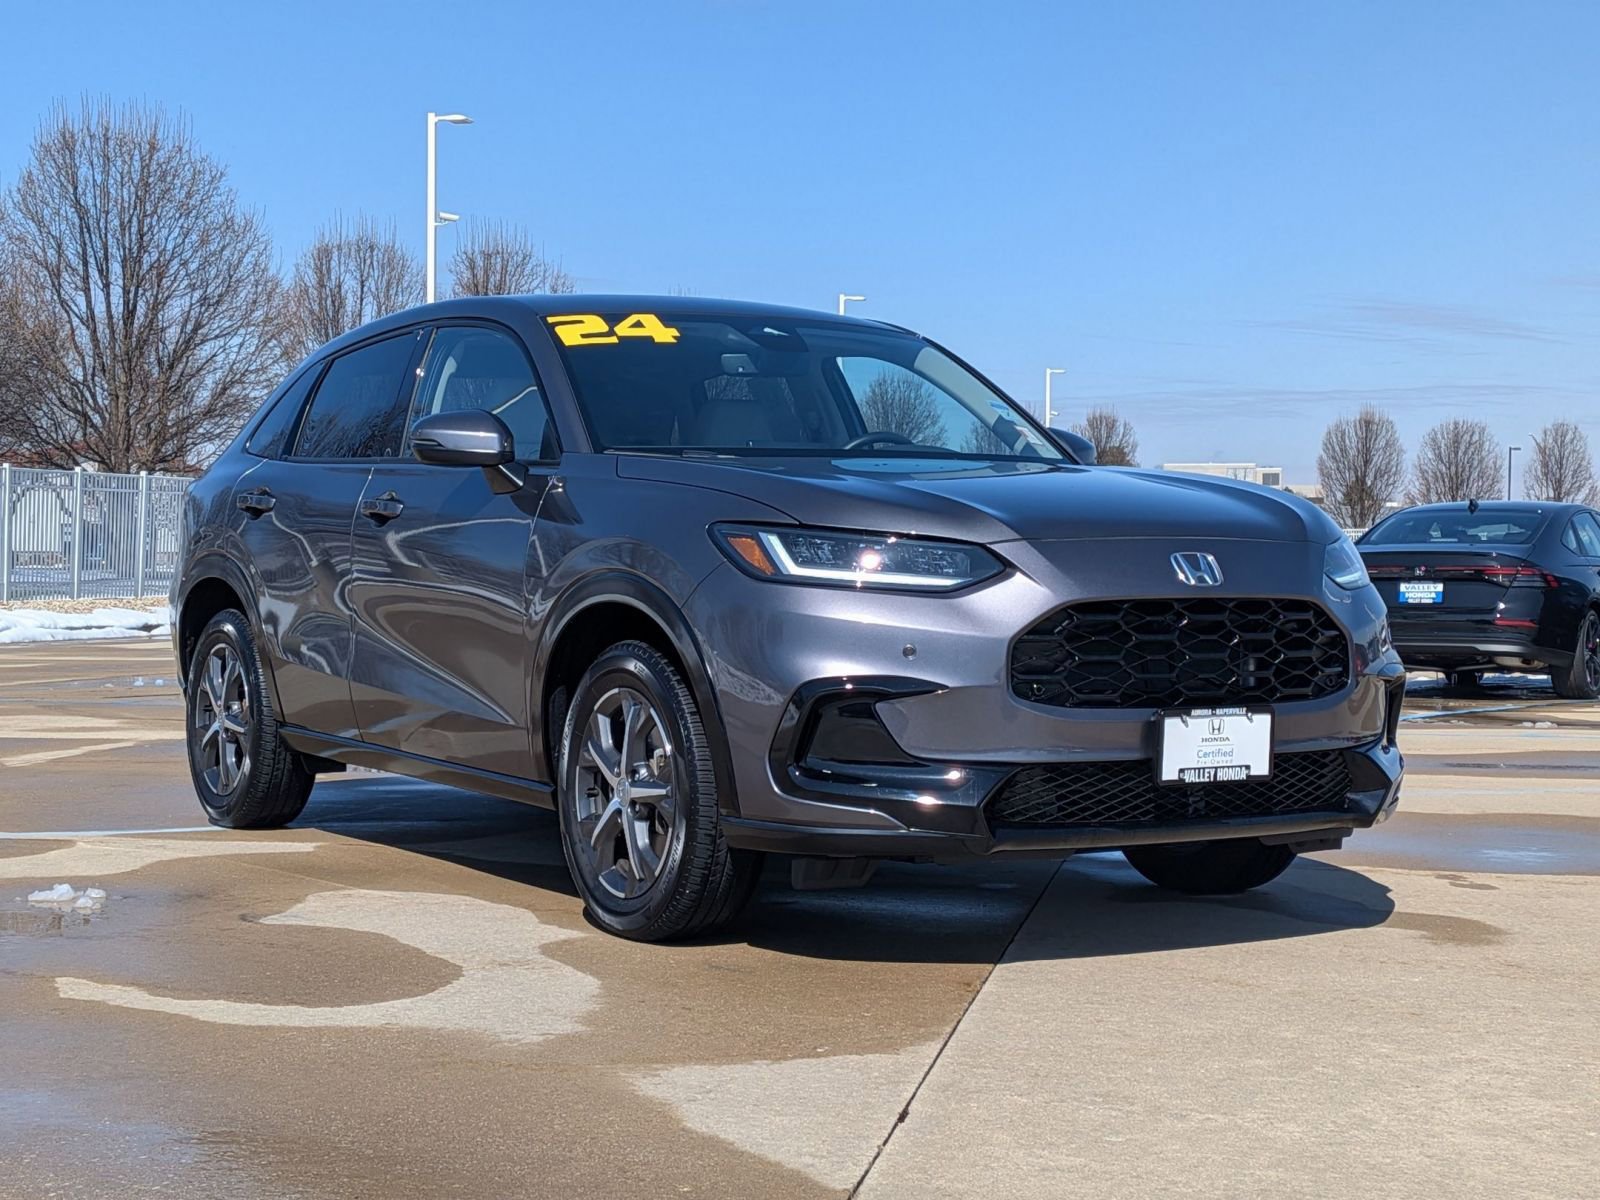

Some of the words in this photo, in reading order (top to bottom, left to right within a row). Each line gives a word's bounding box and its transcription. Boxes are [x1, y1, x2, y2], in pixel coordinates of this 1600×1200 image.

[546, 313, 681, 346] 24
[1197, 748, 1234, 759] Certified
[1184, 768, 1216, 783] VALLEY
[1217, 766, 1247, 781] HONDA
